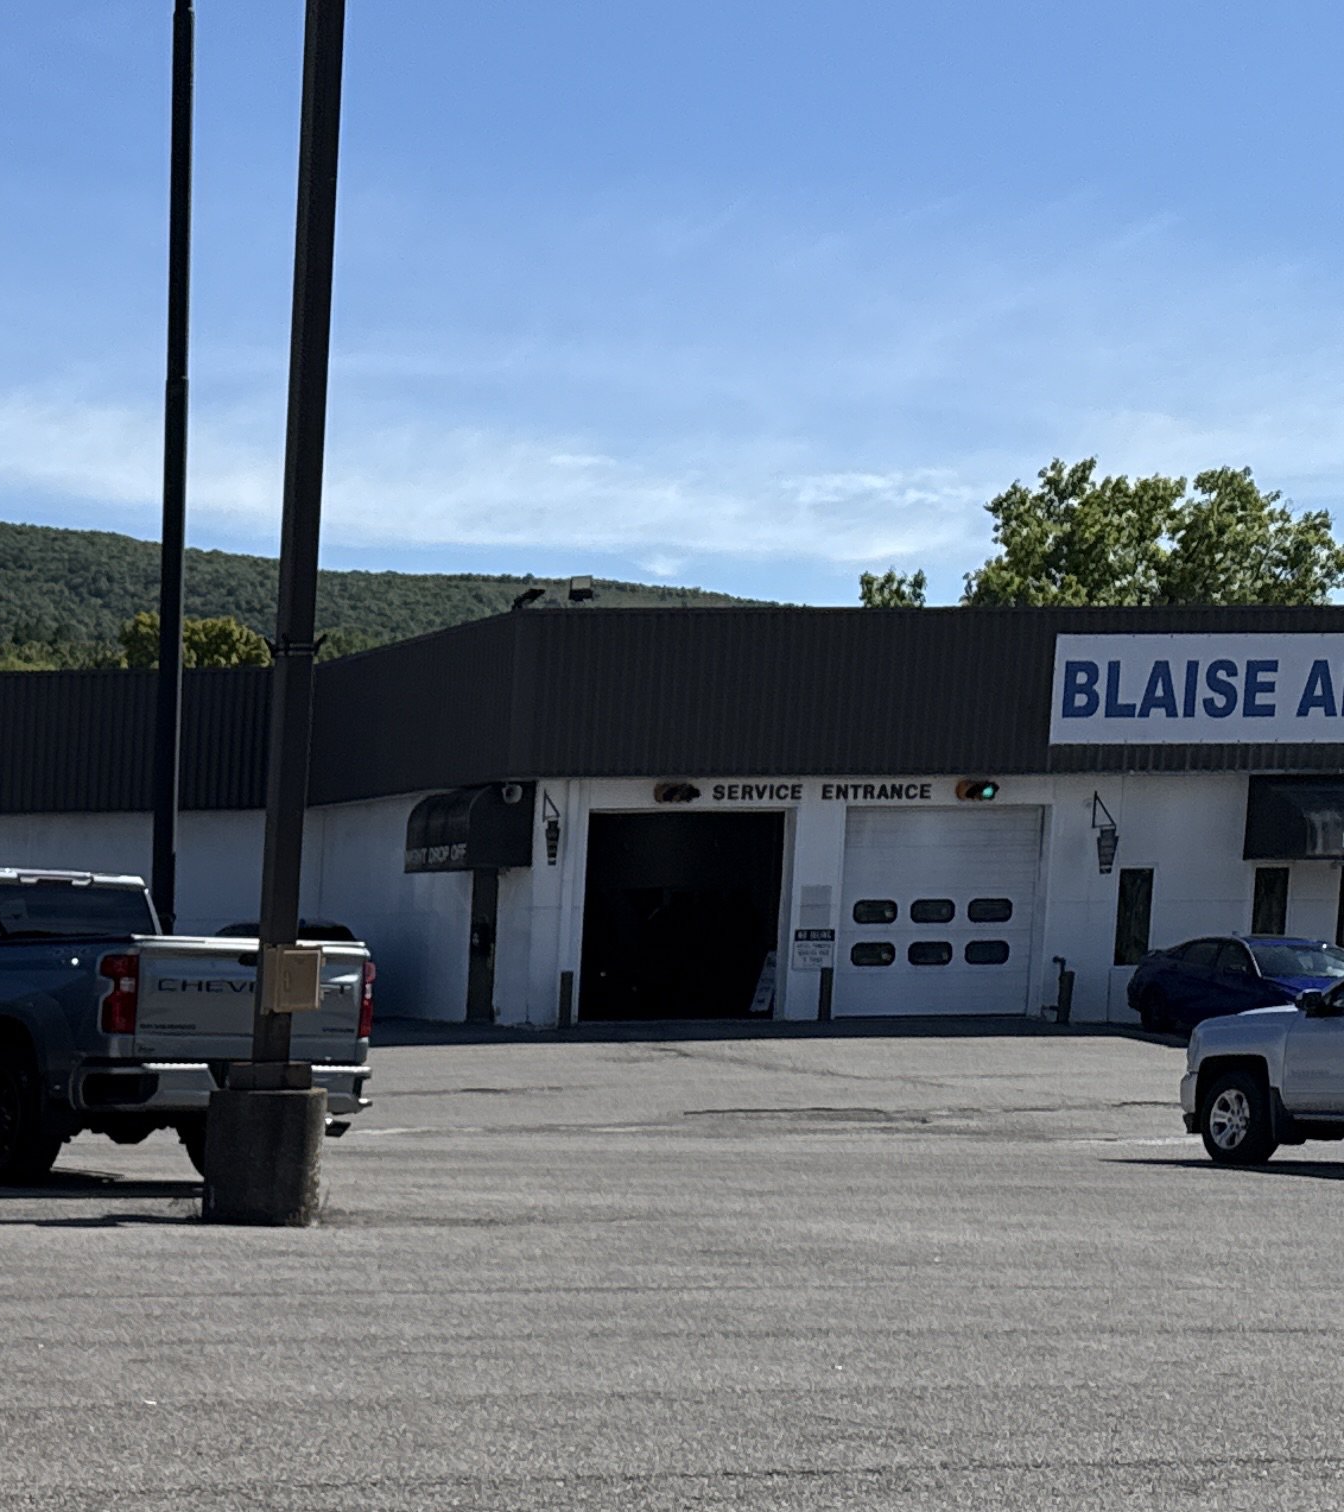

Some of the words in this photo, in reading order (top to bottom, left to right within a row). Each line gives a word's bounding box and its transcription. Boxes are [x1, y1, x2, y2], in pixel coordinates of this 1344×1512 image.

[1062, 659, 1279, 718] BLAISE
[1295, 659, 1344, 718] A
[712, 784, 803, 800] SERVICE
[821, 783, 932, 800] ENTRANCE
